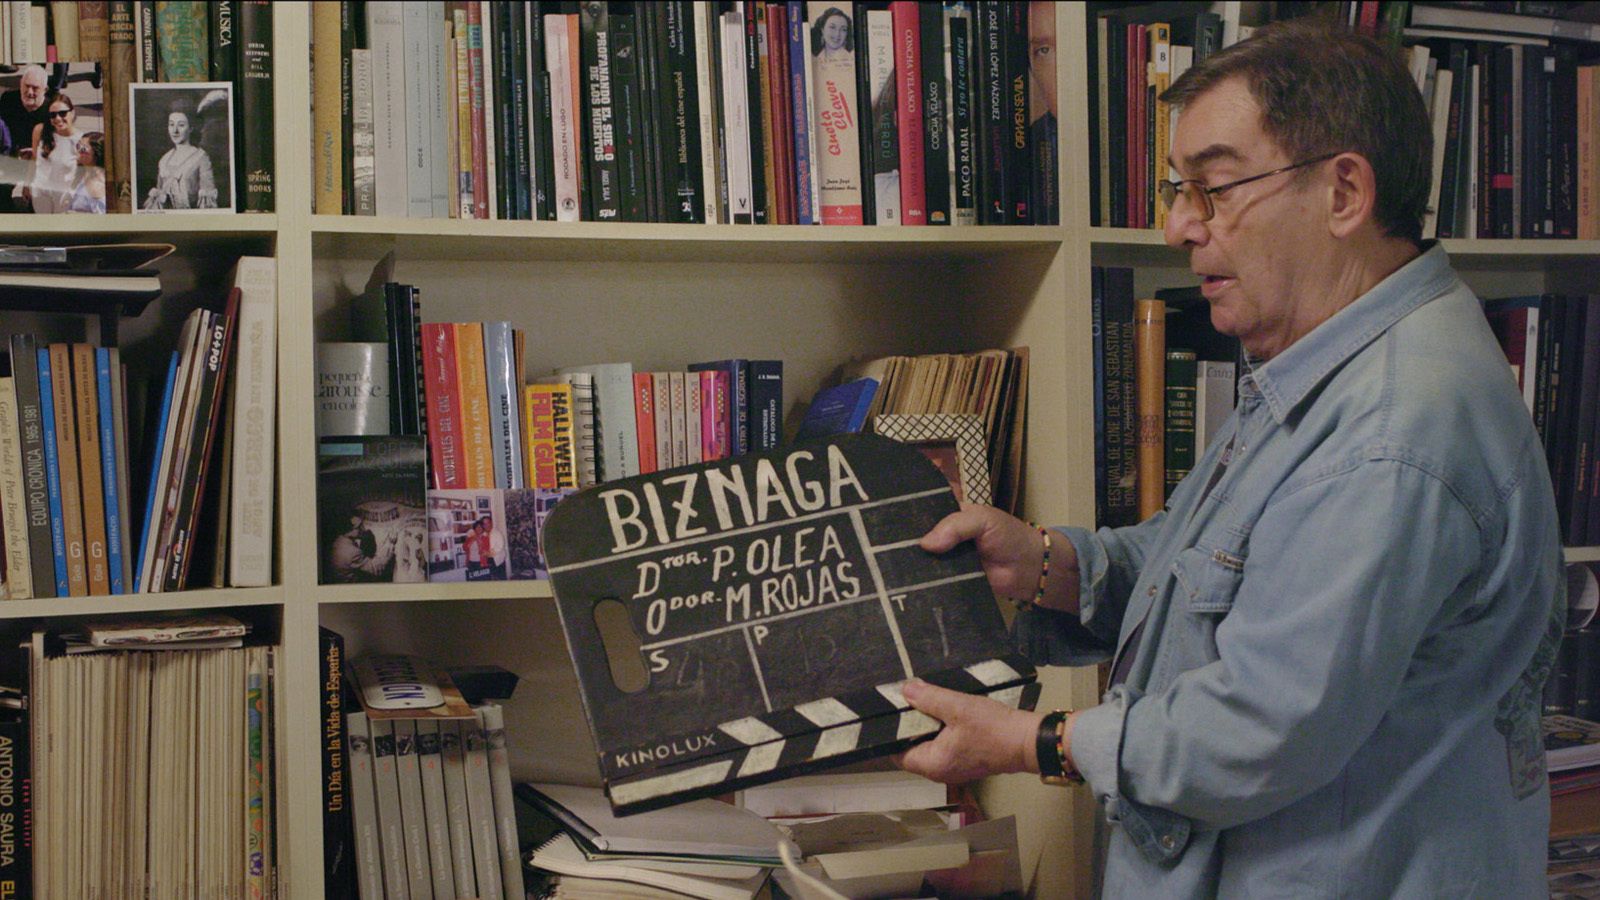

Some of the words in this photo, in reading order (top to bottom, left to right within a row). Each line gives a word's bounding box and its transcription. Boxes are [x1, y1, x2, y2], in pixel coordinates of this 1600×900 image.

[988, 10, 998, 32] JOSÉ
[990, 33, 998, 50] LUIS
[590, 66, 599, 82] DE
[596, 32, 611, 104] PROFANANDO
[990, 52, 999, 77] LÓPEZ
[591, 84, 601, 105] LOS
[990, 80, 1000, 120] VÁZQUEZ
[603, 107, 612, 121] EL
[592, 109, 605, 162] MUERTOS
[960, 126, 970, 163] RABAL
[961, 166, 971, 197] PACO
[209, 324, 224, 372] LO+POP
[1106, 321, 1120, 377] SEBASTIAN
[1106, 380, 1120, 401] SAN
[500, 394, 509, 417] CINE
[531, 392, 553, 440] FILM
[502, 420, 510, 437] DEL
[28, 448, 44, 490] CRONICA
[598, 443, 870, 554] BIZNAGA
[1107, 462, 1121, 508] FESTIVAL
[31, 491, 47, 526] EQUIPO
[893, 594, 906, 612] T
[753, 625, 769, 645] P
[326, 646, 341, 692] España
[650, 650, 670, 673] S
[327, 692, 339, 709] de
[327, 710, 340, 739] Vida
[328, 738, 340, 751] la
[614, 733, 717, 769] KINOLUX
[0, 735, 14, 807] ANTONIO
[331, 752, 340, 769] en
[327, 770, 342, 793] Día
[329, 794, 342, 812] Un
[1, 812, 15, 867] SAURA
